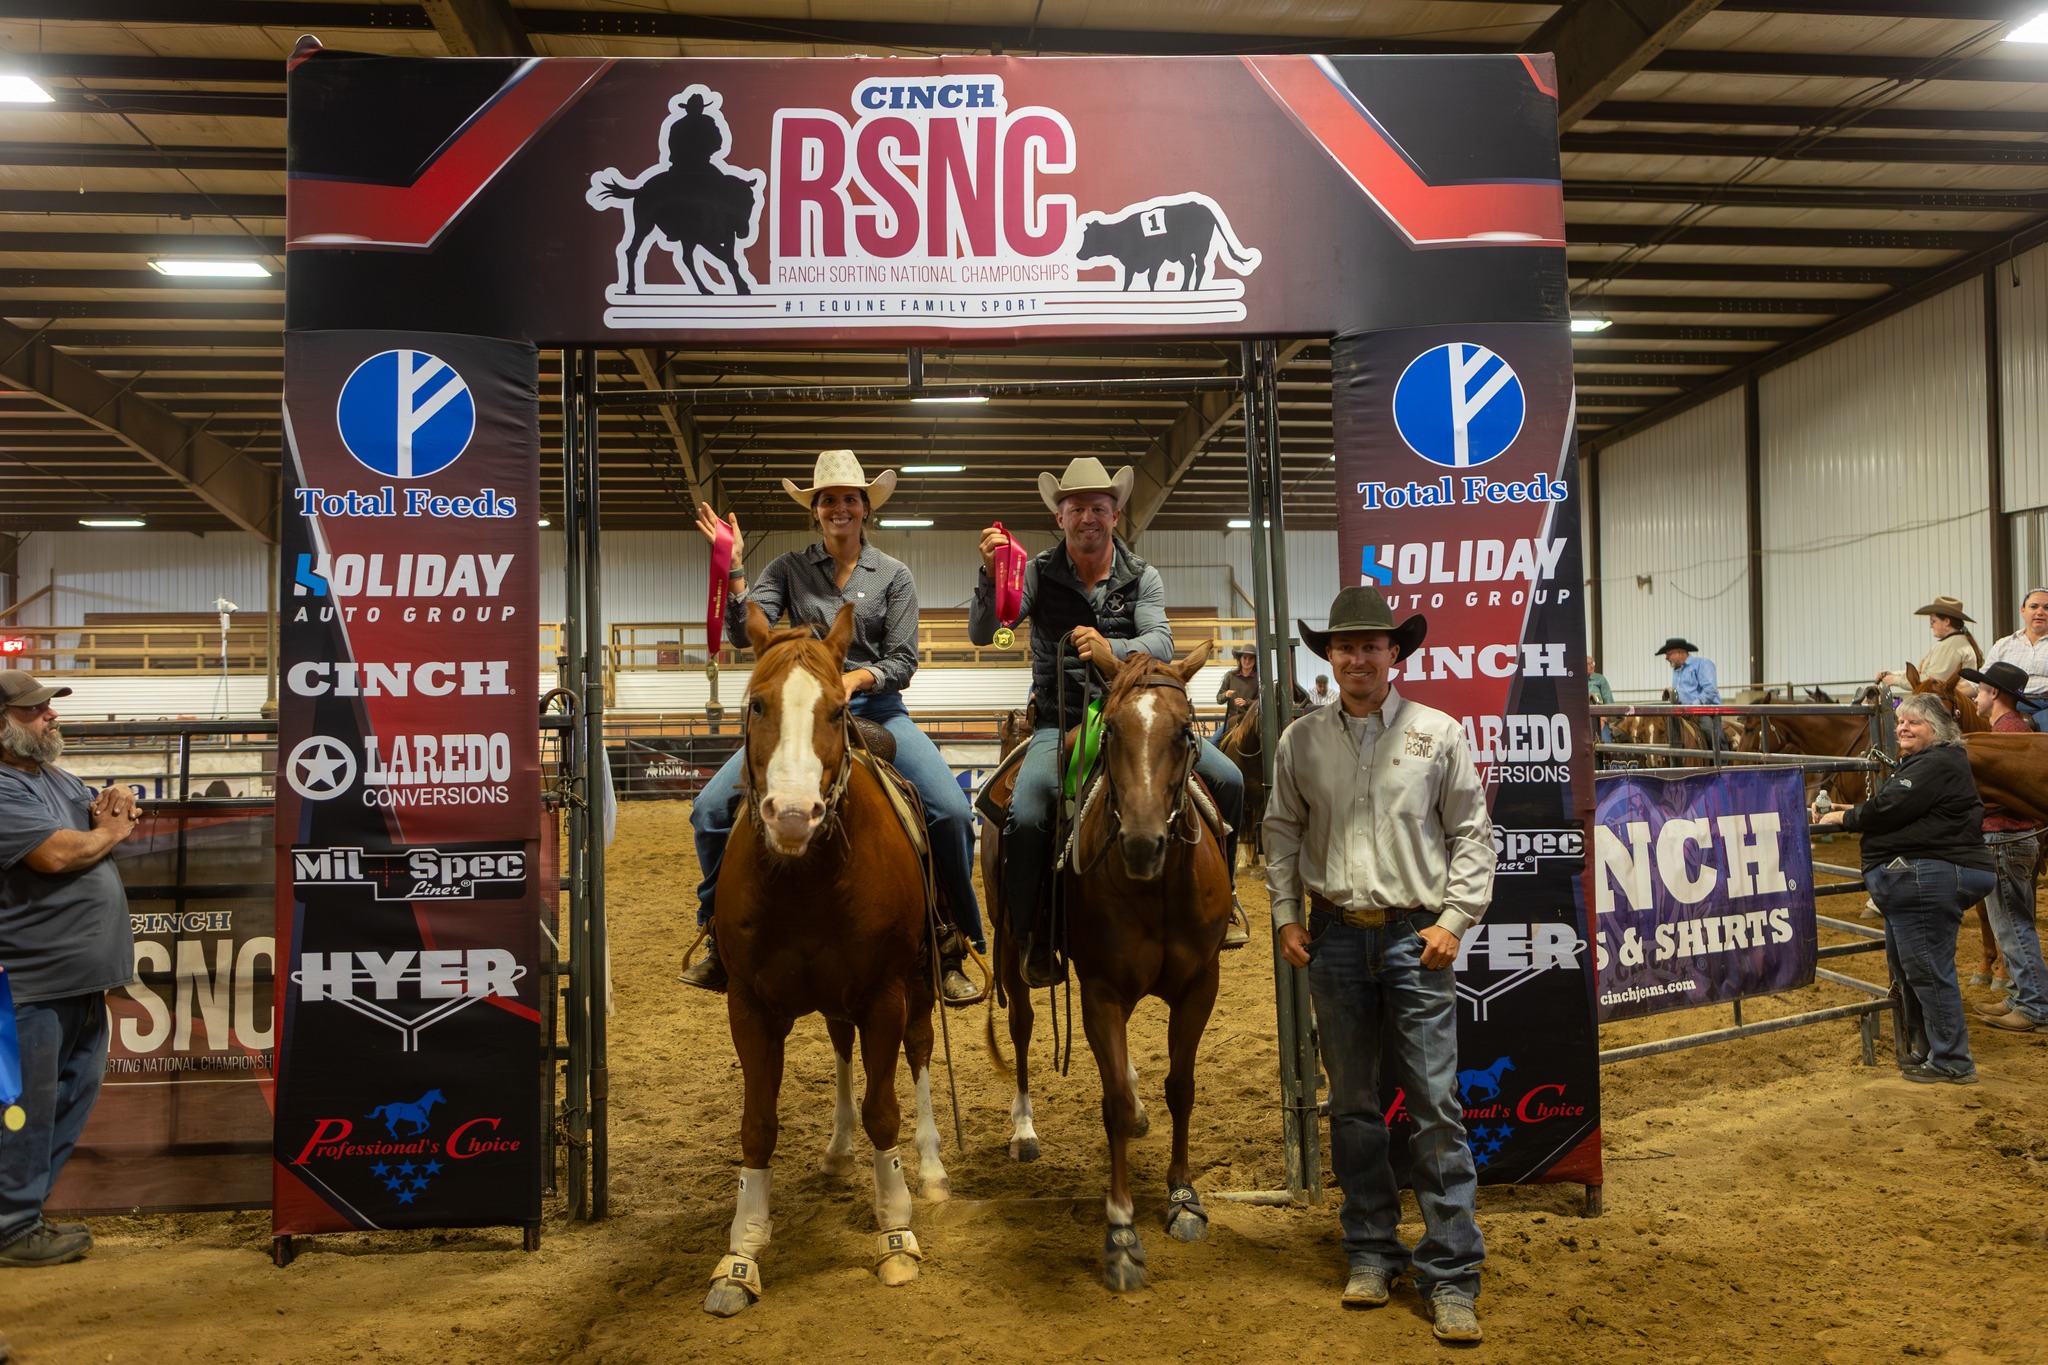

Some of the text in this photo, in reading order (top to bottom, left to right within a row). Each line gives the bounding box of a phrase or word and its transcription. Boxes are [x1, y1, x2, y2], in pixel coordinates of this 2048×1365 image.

[860, 83, 995, 110] CINCH
[778, 115, 1068, 258] RSNC
[1147, 213, 1160, 232] 1
[779, 263, 1069, 283] RANCH SORTING NATIONAL CHAMPIONSHIPS
[785, 299, 1037, 312] #1 EQUINE FAMILY SPORT
[295, 486, 517, 518] Total Feeds
[1358, 473, 1568, 510] Total Feeds
[294, 553, 516, 597] HOLIDAY
[1361, 537, 1568, 586] HOLIDAY
[294, 606, 516, 623] AUTO GROUP
[1387, 589, 1570, 611] UTO GROUP
[287, 661, 510, 697] CINCH
[1388, 643, 1568, 682] INCH
[1404, 742, 1433, 758] RSNC
[1461, 713, 1572, 763] AREDO
[364, 732, 512, 786] LAREDO
[1475, 765, 1571, 785] VERSIONS
[363, 786, 510, 807] CONVERSIONS
[295, 851, 525, 885] Mil Spec
[1496, 860, 1526, 870] ner
[1594, 812, 1788, 914] NCH
[406, 880, 461, 898] Liner
[129, 911, 232, 934] CINCH
[1619, 927, 1644, 966] &
[1655, 907, 1794, 962] SHIRTS
[1452, 922, 1581, 972] YER
[301, 948, 520, 1002] HYER
[106, 936, 276, 1053] SNC
[143, 1057, 198, 1072] NATIONAL
[200, 1054, 275, 1071] CHAMPIONSH
[1516, 1084, 1585, 1123] Choice
[290, 1117, 521, 1165] Professional's Choice
